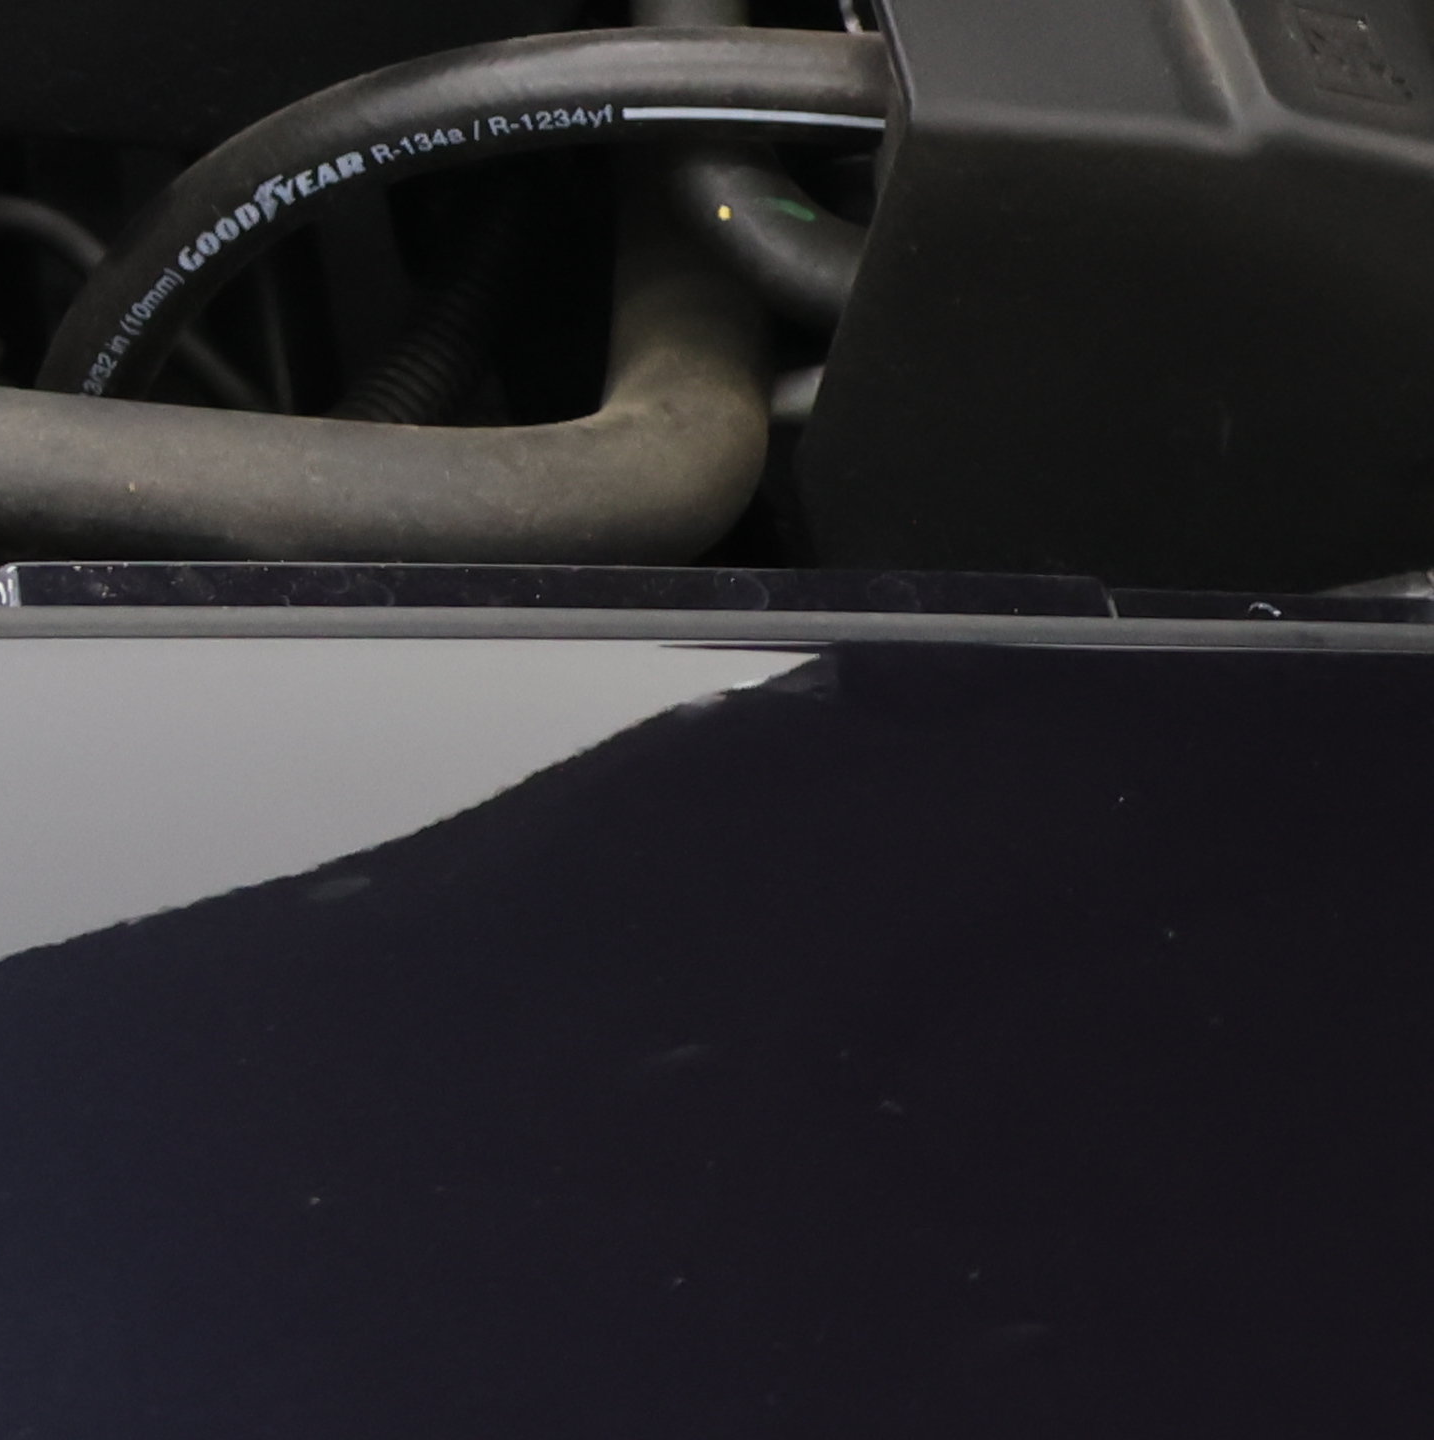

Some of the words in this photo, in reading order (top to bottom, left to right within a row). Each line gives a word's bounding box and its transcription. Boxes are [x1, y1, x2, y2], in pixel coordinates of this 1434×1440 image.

[104, 335, 130, 355] in
[120, 267, 185, 335] (10mm)
[178, 150, 366, 272] GOODYEAR
[371, 126, 466, 165] R-134a
[488, 105, 613, 137] R-1234yf
